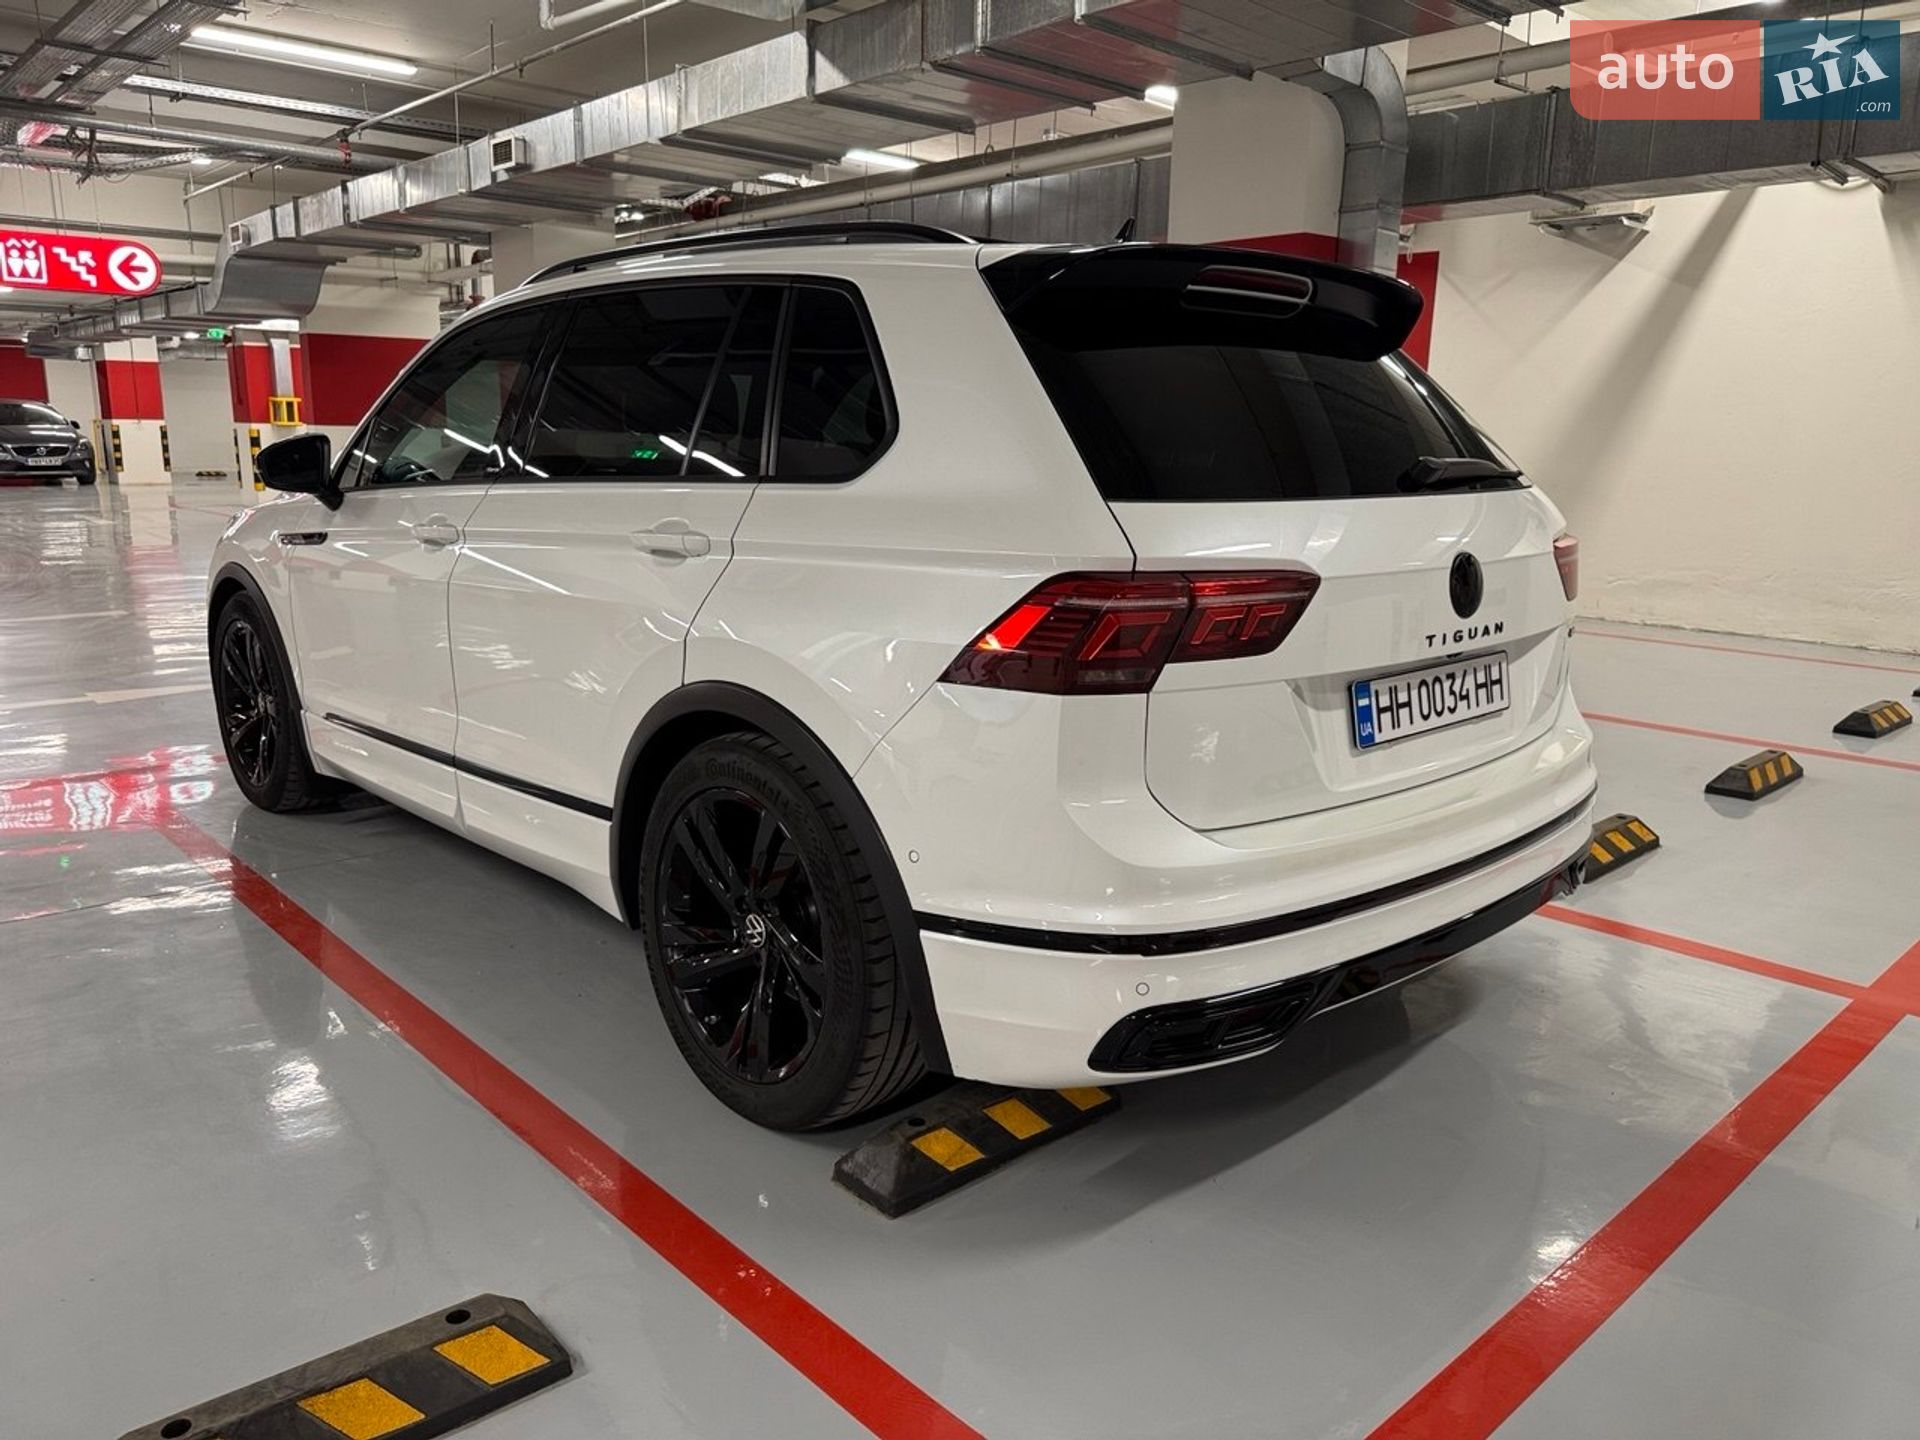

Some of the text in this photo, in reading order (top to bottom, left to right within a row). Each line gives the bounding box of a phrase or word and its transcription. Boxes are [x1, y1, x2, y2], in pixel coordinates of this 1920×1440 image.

[1425, 621, 1504, 648] TIGUAN
[1374, 661, 1504, 733] HH 0034 HH
[1360, 721, 1374, 736] UA
